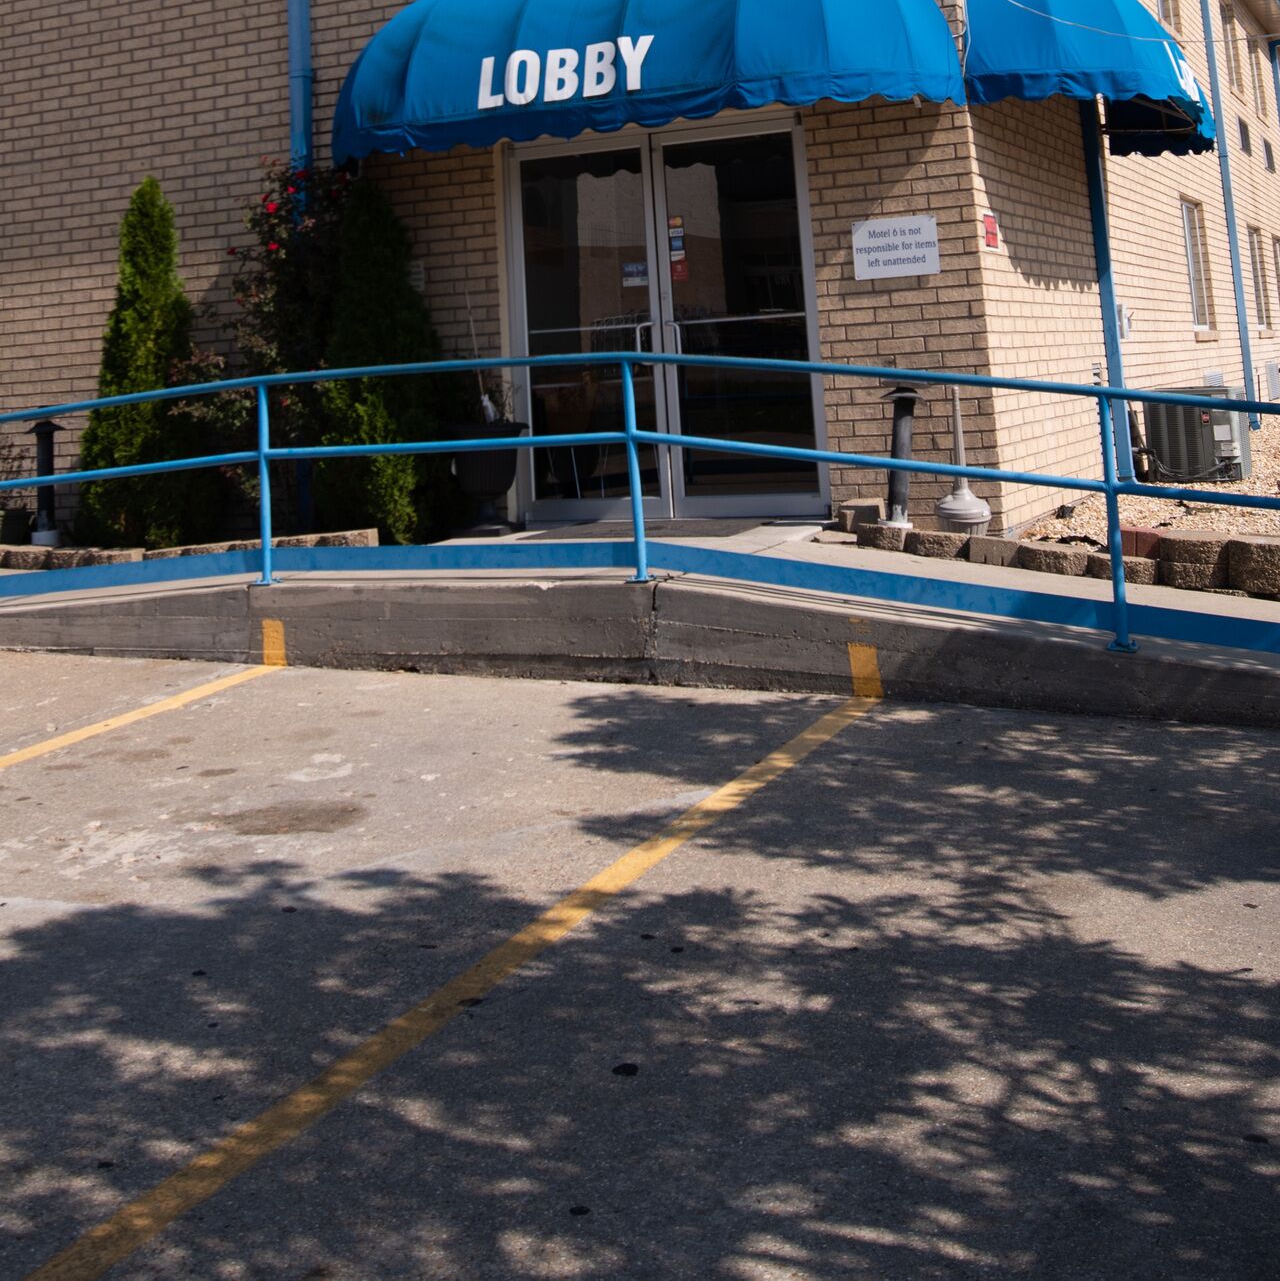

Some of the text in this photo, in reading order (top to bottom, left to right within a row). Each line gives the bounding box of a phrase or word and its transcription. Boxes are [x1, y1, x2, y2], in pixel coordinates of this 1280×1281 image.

[477, 34, 655, 110] LOBBY
[868, 227, 921, 239] Motel 6 is not
[856, 239, 936, 255] responsible for items
[868, 254, 926, 268] left unattended
